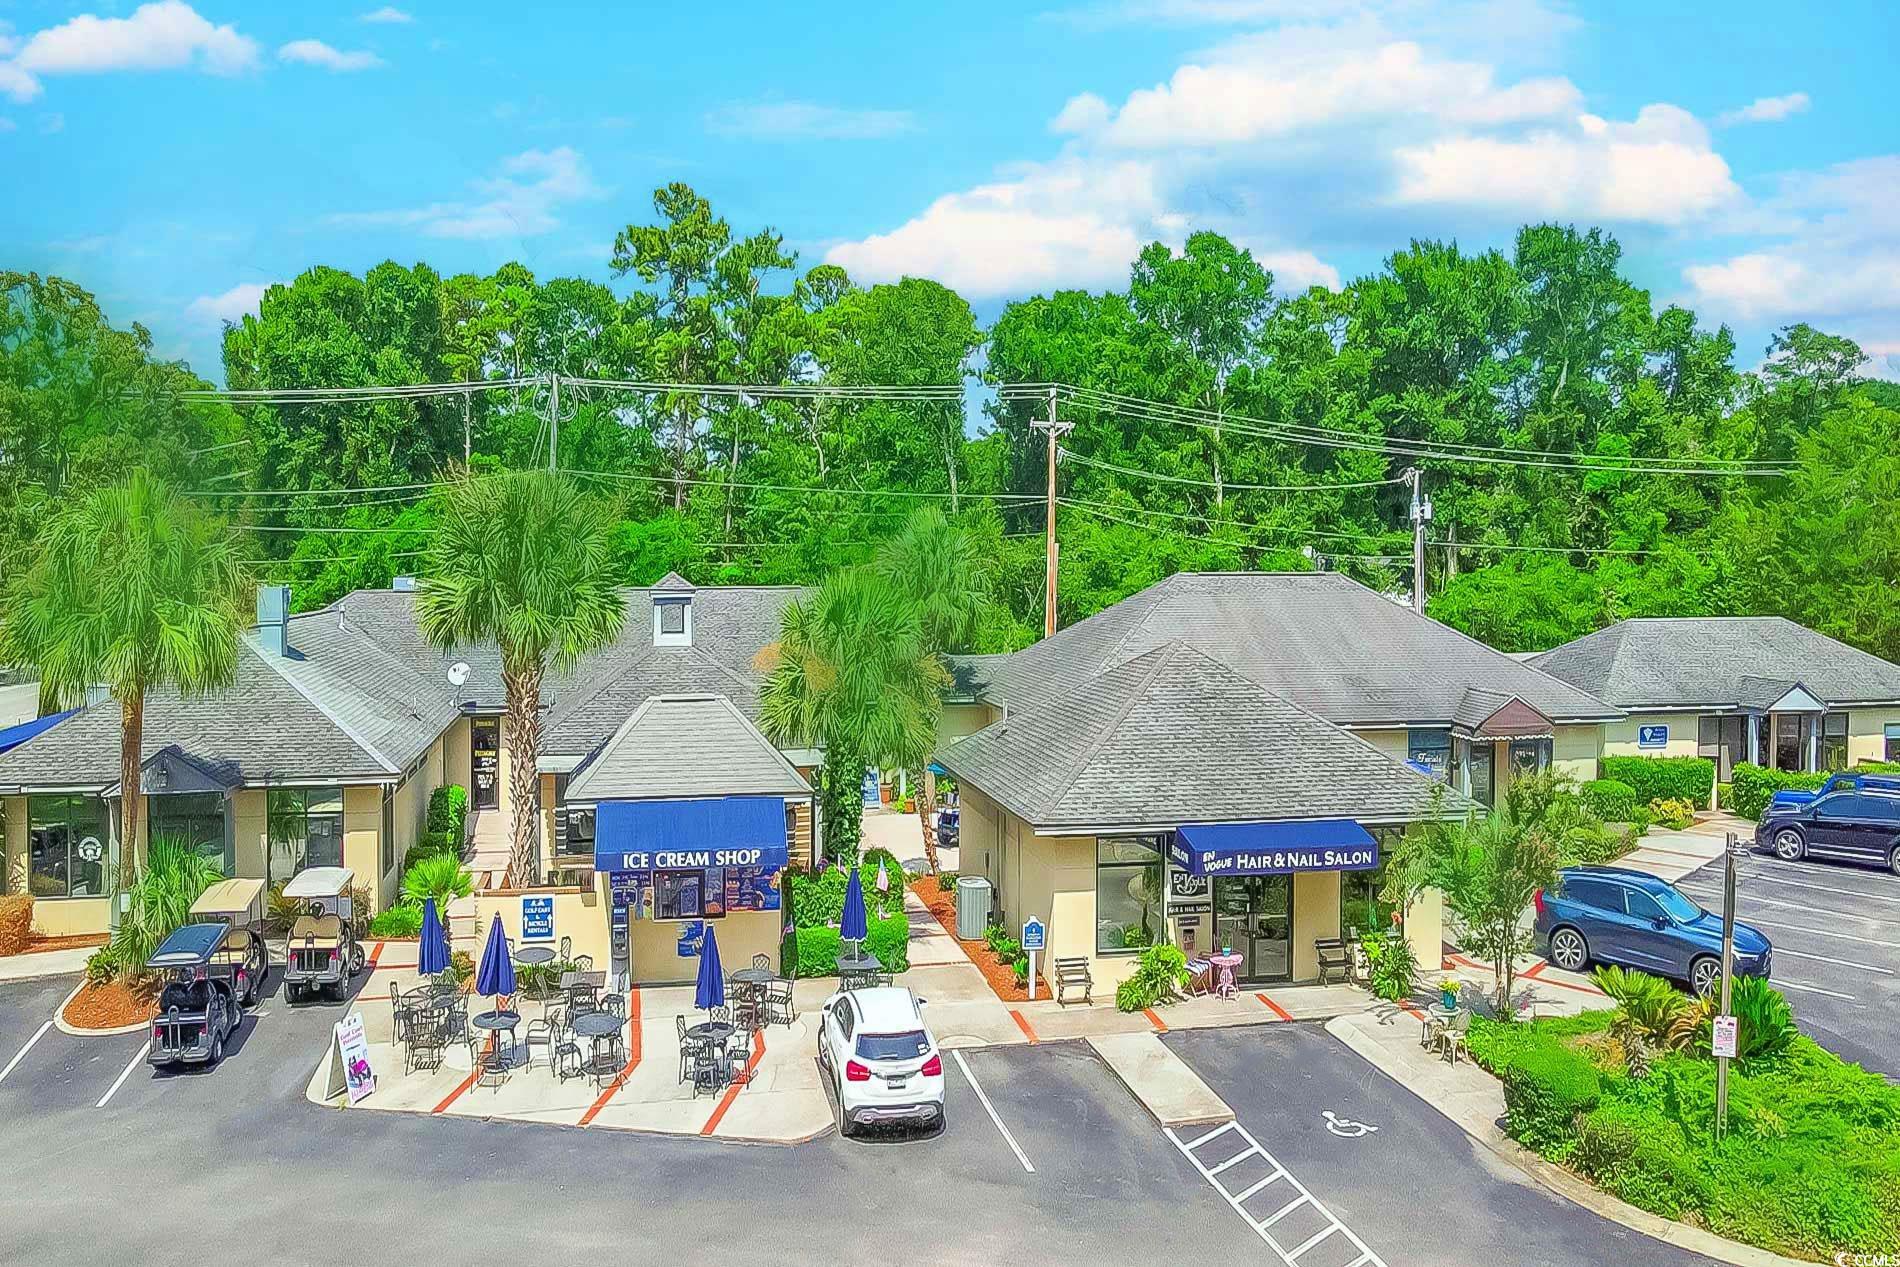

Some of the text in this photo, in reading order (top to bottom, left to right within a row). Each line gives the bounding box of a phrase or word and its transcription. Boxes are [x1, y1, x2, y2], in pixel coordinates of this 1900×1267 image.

[623, 849, 761, 869] ICE CREAM SHOP
[1203, 850, 1216, 863] EN
[1204, 857, 1233, 873] VOGUE
[1236, 850, 1372, 869] HAIR & NAIL SALON
